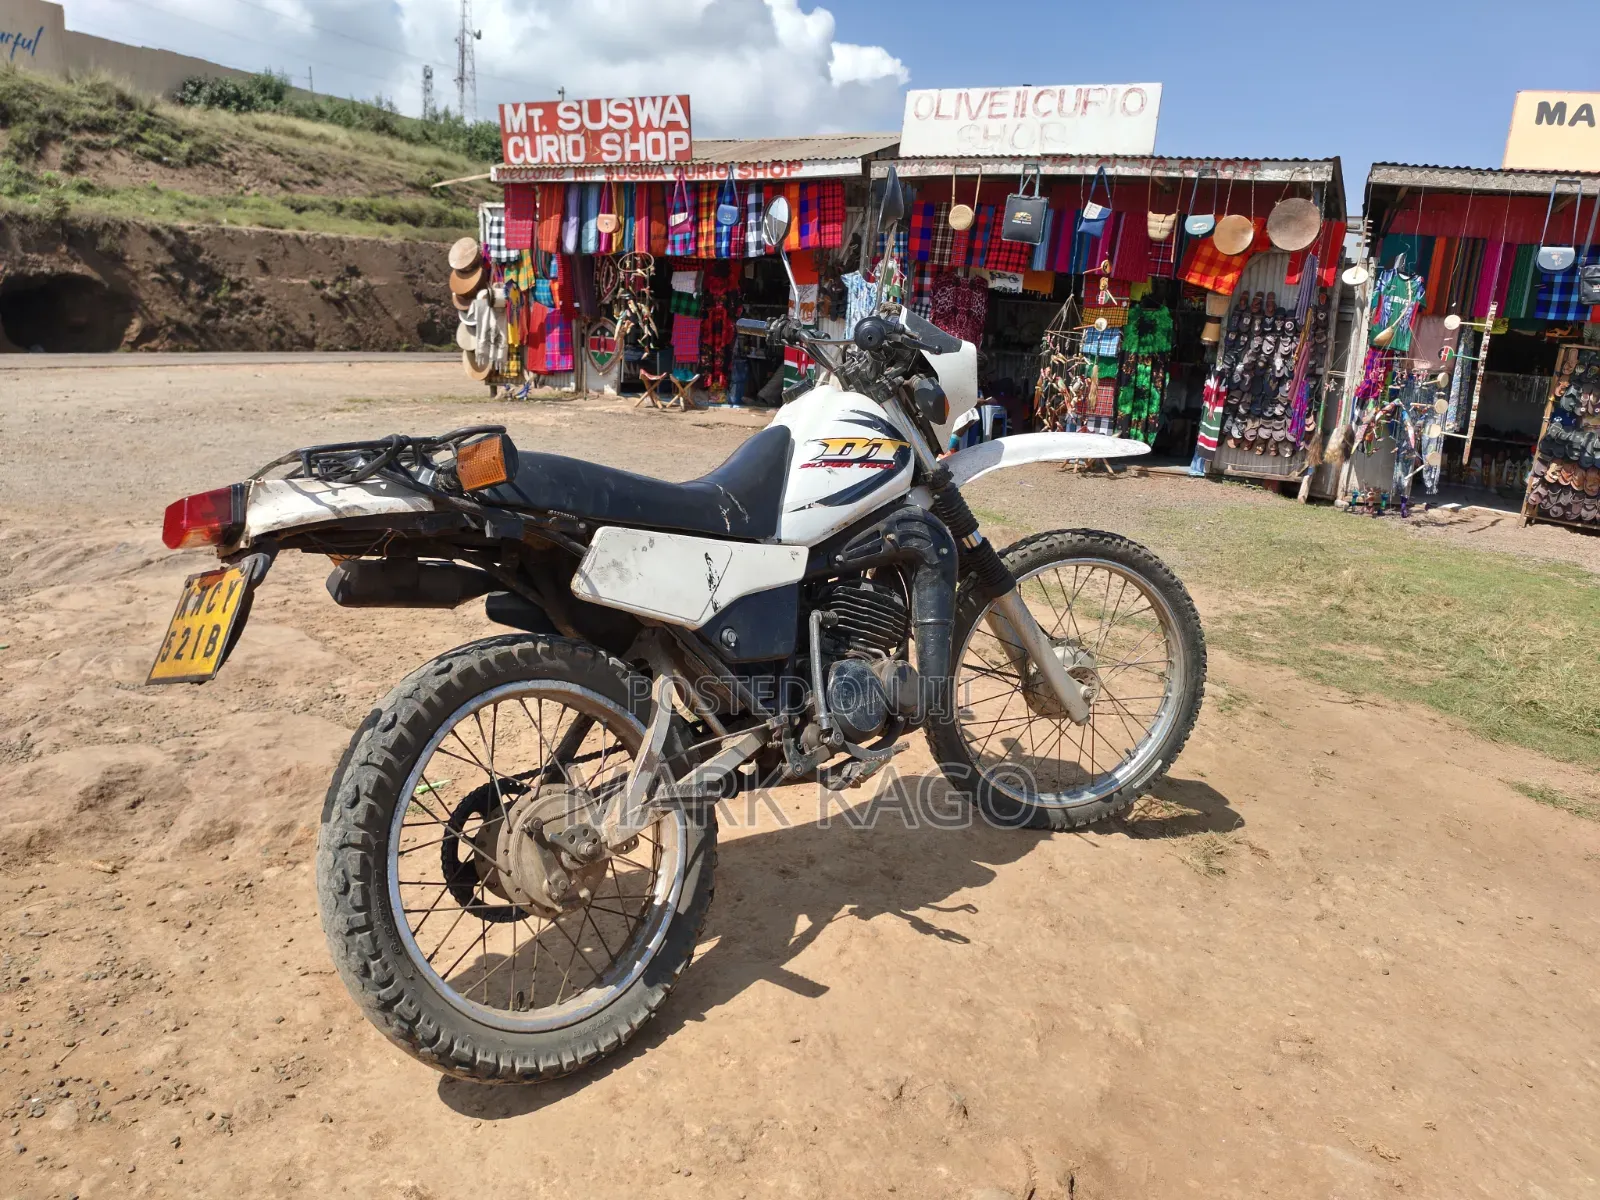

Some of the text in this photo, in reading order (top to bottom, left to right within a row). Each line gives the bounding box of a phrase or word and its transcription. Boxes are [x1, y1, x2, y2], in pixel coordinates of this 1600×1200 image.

[557, 95, 690, 131] SUSWA
[914, 91, 1009, 121] OLIVE
[1535, 101, 1596, 128] MA
[507, 131, 690, 164] CURIO SHOP
[957, 122, 1069, 153] SHOP
[604, 164, 667, 181] SUSWA
[673, 163, 729, 180] CURIO
[738, 160, 803, 180] SHOP
[808, 437, 911, 461] DT
[160, 624, 220, 663] 521B
